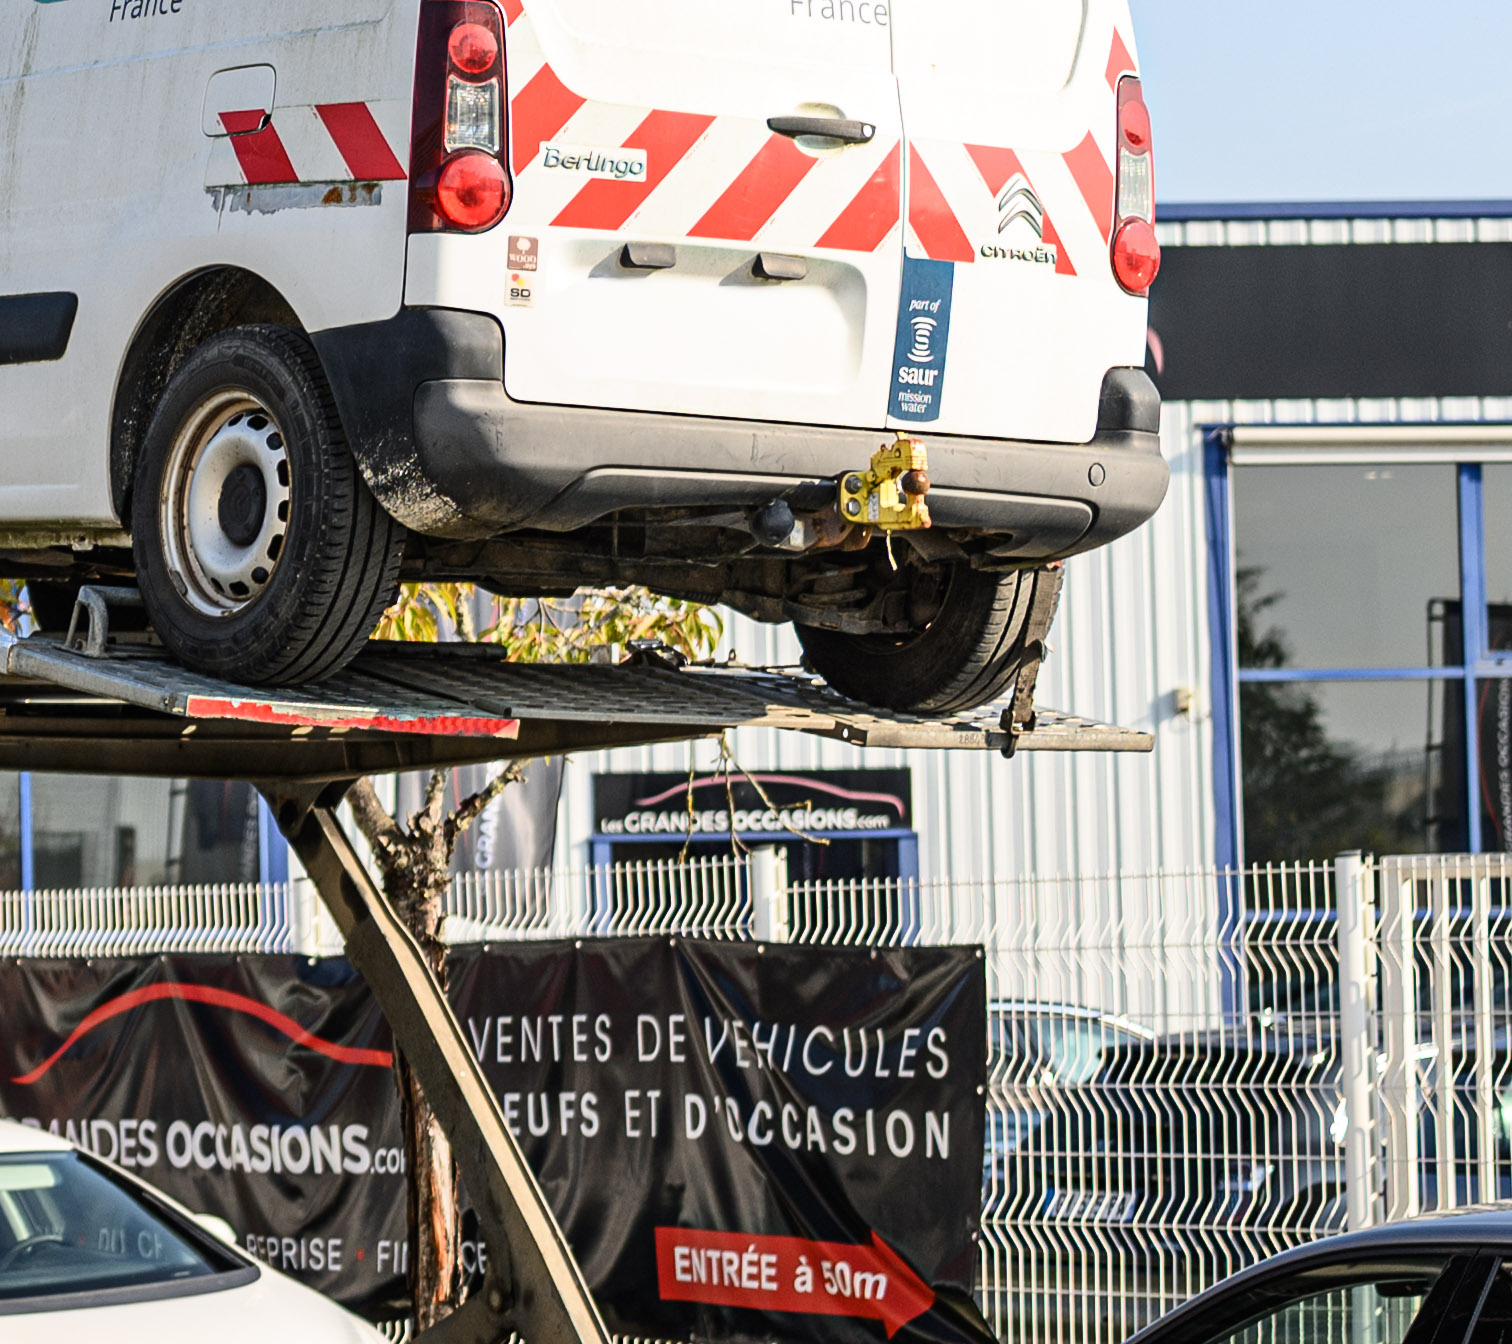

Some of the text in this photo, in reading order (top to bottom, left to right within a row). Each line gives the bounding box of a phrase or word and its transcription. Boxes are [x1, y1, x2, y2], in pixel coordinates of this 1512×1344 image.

[543, 146, 644, 179] Berlingo
[510, 287, 531, 298] SD
[908, 298, 942, 314] part of
[898, 366, 939, 387] saur
[897, 389, 932, 405] mission
[901, 402, 928, 414] water
[601, 817, 624, 833] Les
[624, 809, 727, 834] GRANDES
[468, 1013, 950, 1081] VENTES DE VEHICULES
[503, 1089, 951, 1160] EUFS ET D'OCCASION
[673, 1243, 889, 1303] ENTRÉE à 50m
